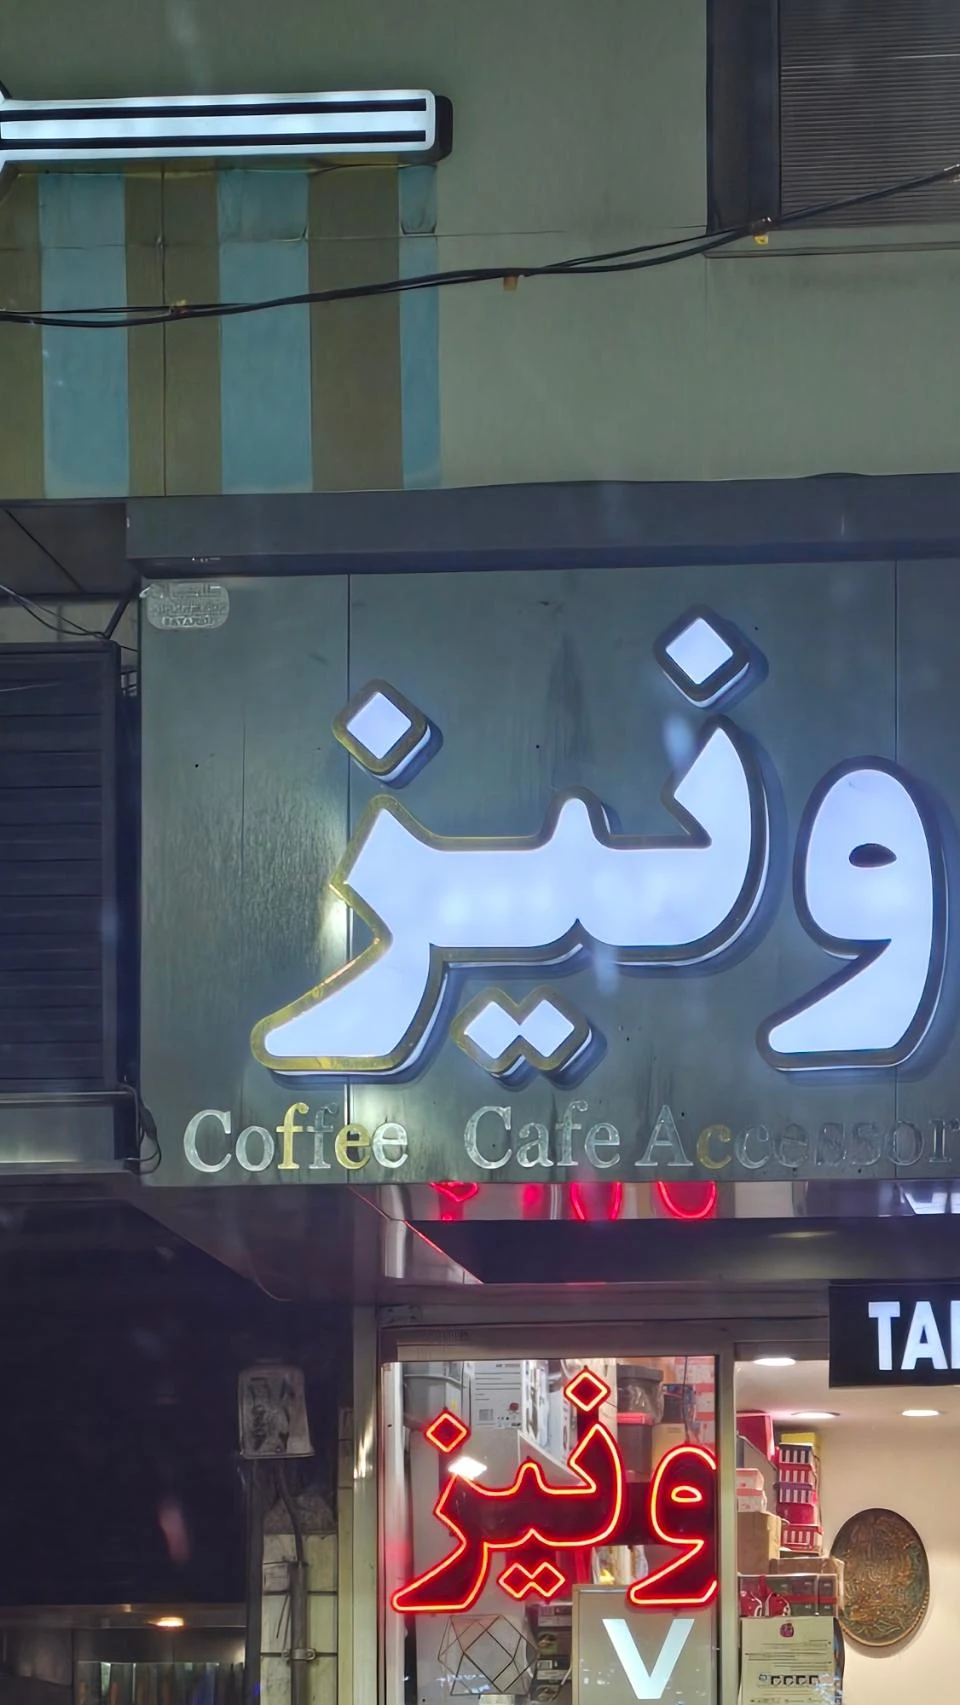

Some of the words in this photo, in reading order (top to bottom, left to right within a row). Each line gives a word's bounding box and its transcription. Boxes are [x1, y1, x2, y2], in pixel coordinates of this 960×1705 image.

[252, 606, 948, 1072] ونیز
[183, 1101, 409, 1173] Coffee
[464, 1100, 621, 1169] Cafe
[391, 1368, 717, 1613] ونیز
